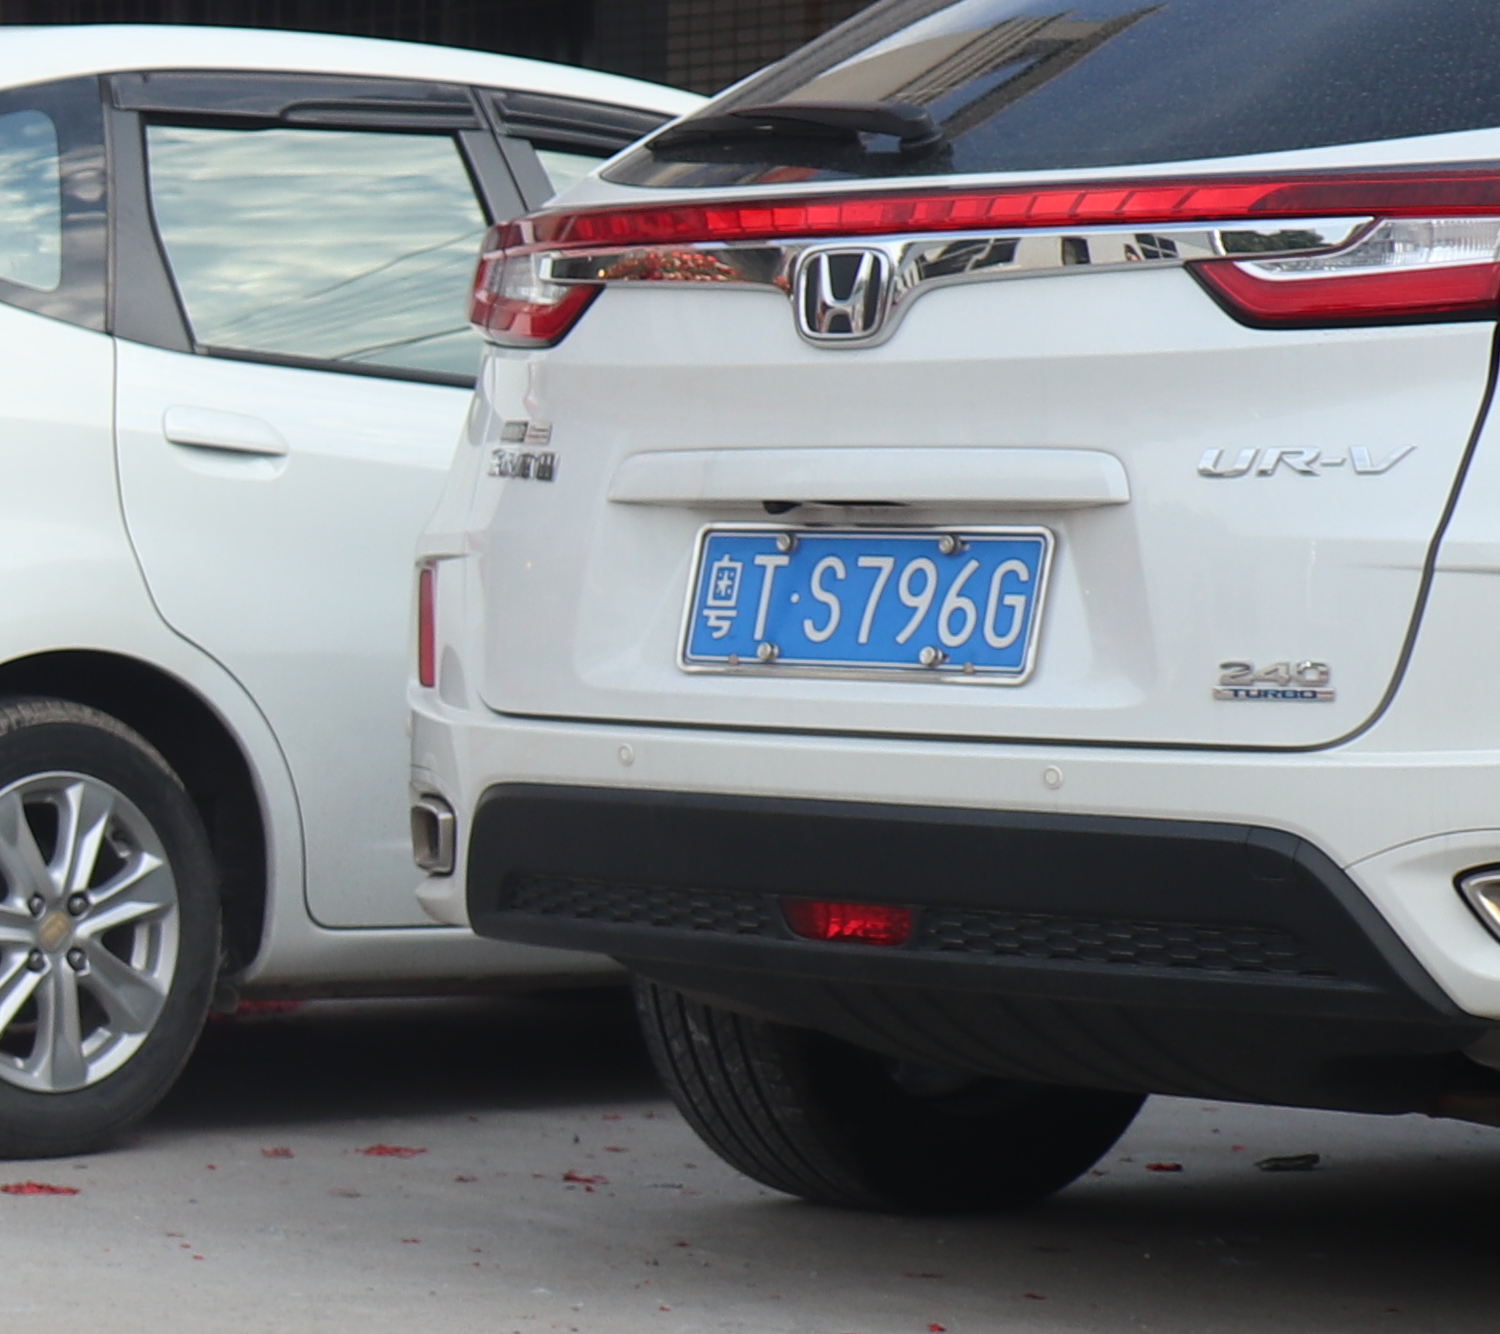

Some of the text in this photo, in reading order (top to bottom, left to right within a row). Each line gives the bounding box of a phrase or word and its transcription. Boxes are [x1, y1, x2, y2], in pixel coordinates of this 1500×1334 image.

[1197, 444, 1418, 478] UR-V
[1218, 660, 1330, 687] 240
[1231, 688, 1318, 700] TURBO
